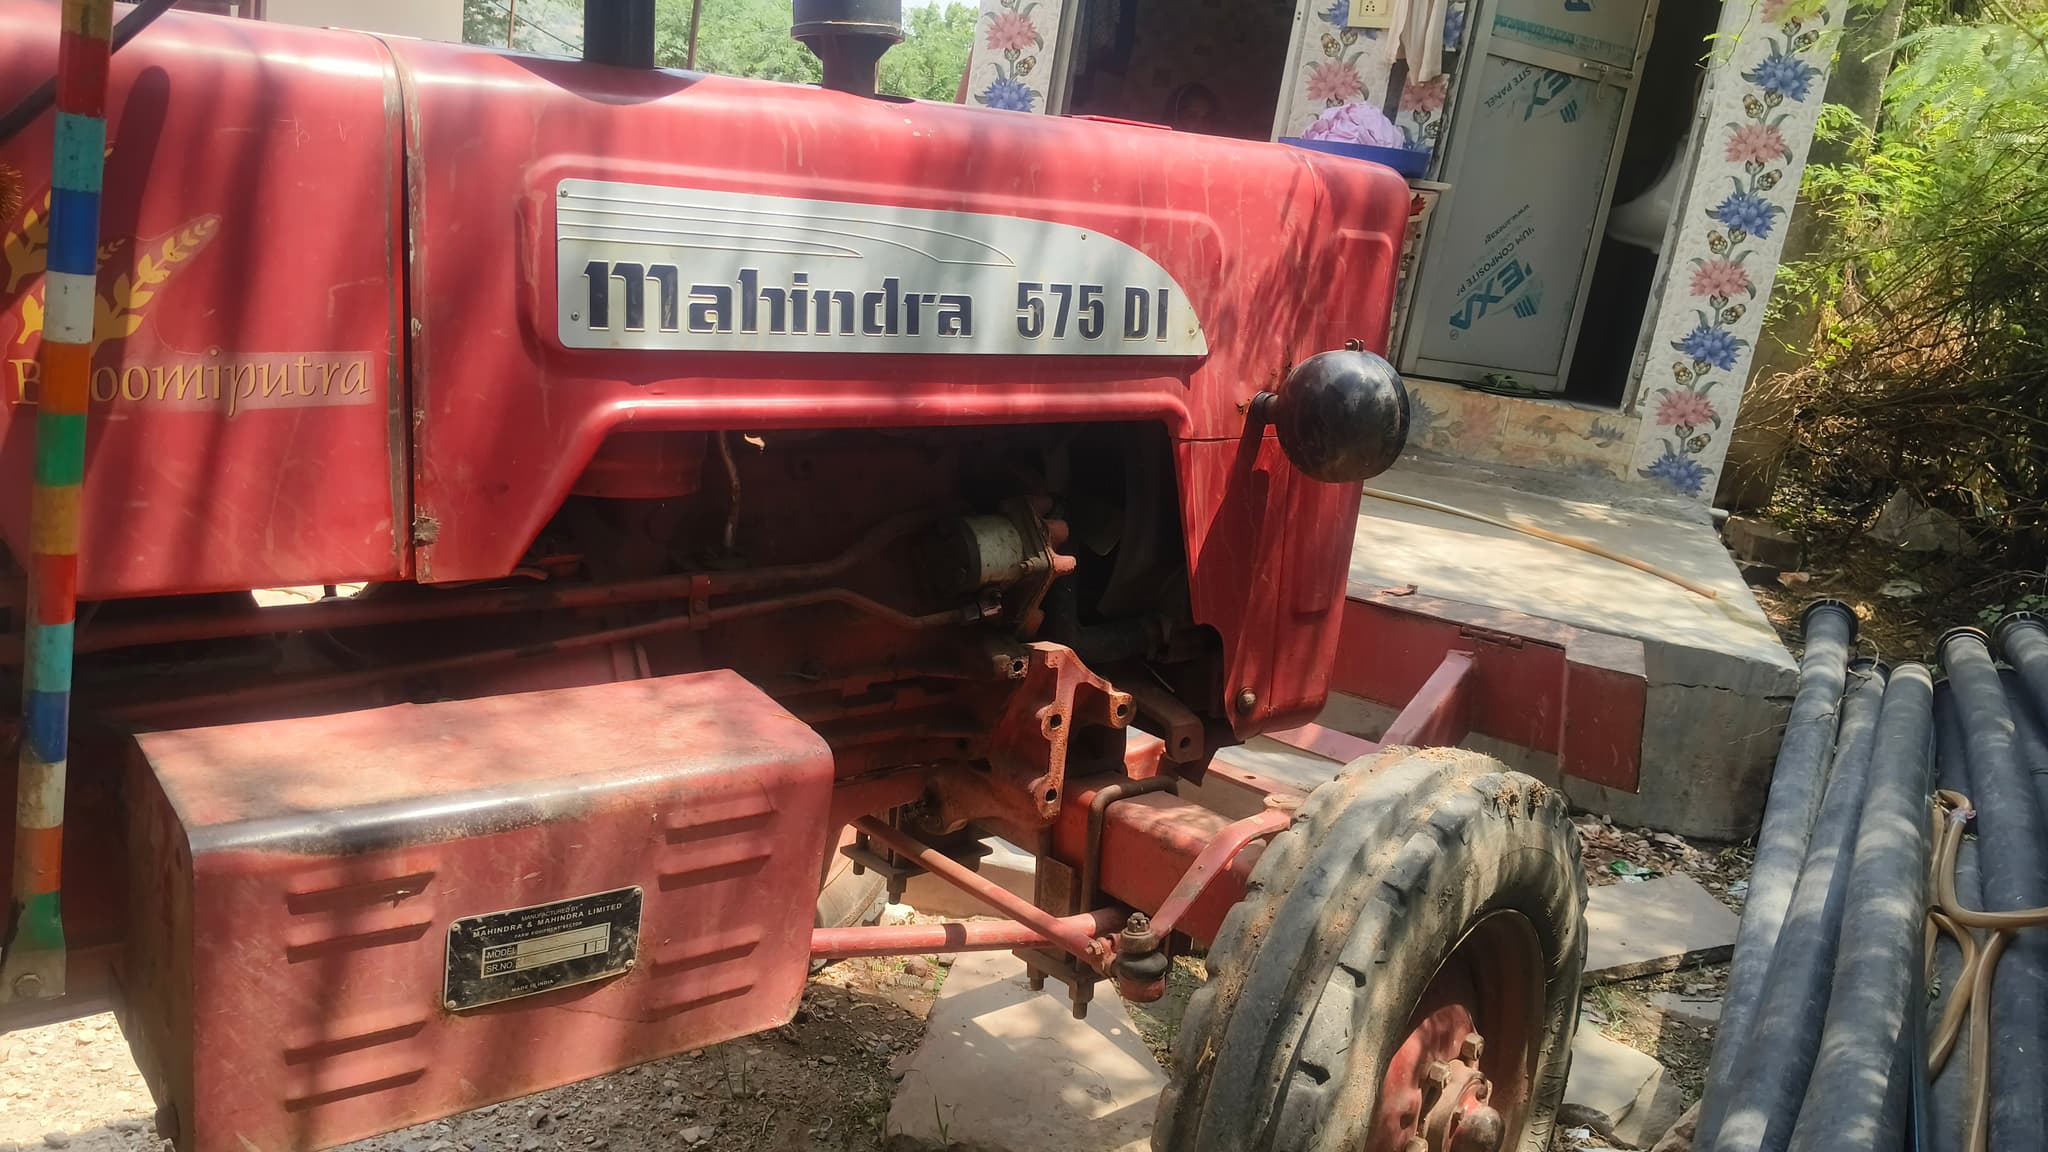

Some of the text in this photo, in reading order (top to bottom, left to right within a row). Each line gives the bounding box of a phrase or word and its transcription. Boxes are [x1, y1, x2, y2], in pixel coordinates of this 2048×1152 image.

[1484, 82, 1512, 108] PANEL
[1467, 241, 1515, 288] COMPOSITE
[583, 260, 1169, 343] Mahindra 575 DI
[8, 348, 370, 417] Boomiputra
[472, 923, 523, 938] MAHINDRA
[537, 911, 584, 926] MAHINDRA
[588, 903, 622, 916] LIMITED
[521, 906, 570, 921] MANUFACTURED
[486, 946, 516, 959] MODEL
[537, 979, 554, 987] INDIA
